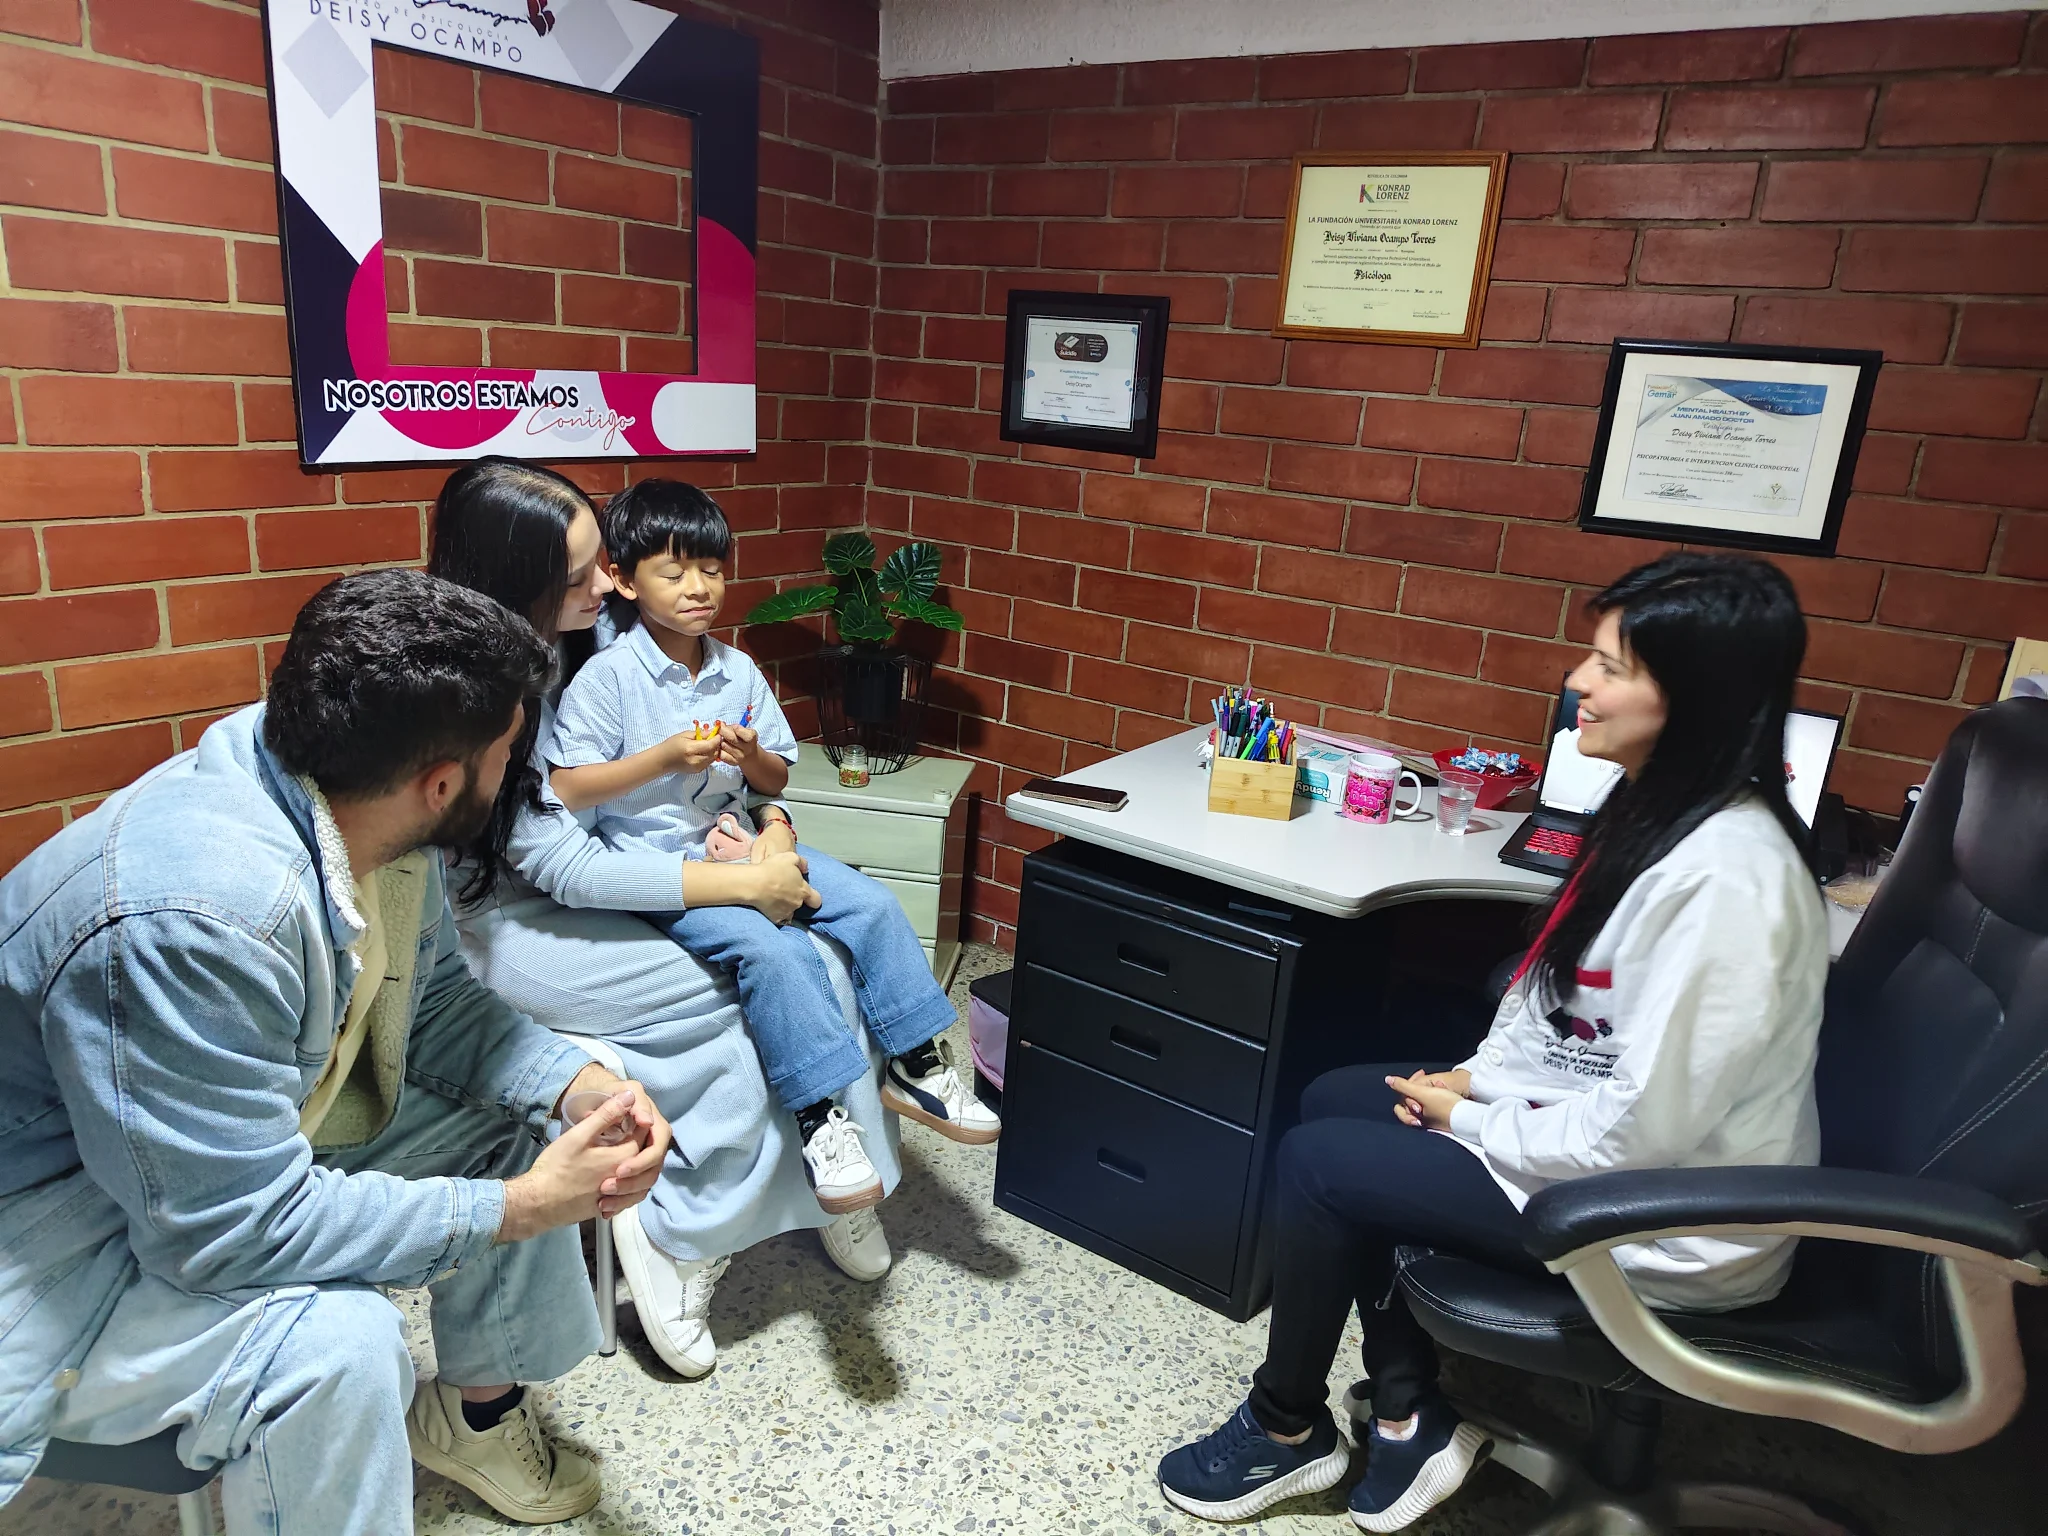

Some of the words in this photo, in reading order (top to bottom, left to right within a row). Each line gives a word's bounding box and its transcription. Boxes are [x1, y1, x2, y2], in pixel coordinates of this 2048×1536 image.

[310, 0, 390, 32] DEISY
[411, 22, 522, 62] OCAMPO
[1377, 184, 1411, 192] KONRAD
[1376, 192, 1410, 200] LORENZ
[1354, 217, 1402, 225] UNIVERSITARIA
[1403, 218, 1431, 226] KONRAD
[1323, 230, 1345, 245] Deisy
[1346, 230, 1377, 242] Viviana
[1411, 231, 1436, 244] Torres
[1354, 269, 1392, 282] Psicóloga
[325, 380, 470, 411] NOSOTROS
[477, 383, 579, 408] ESTAMOS
[1647, 390, 1676, 399] Gemar
[525, 401, 635, 450] Contigo
[1672, 428, 1693, 439] Deisy
[1694, 430, 1721, 440] Viviana
[1723, 432, 1753, 443] Ocampo
[1755, 434, 1777, 444] Torres
[1759, 464, 1800, 472] CONDUCTUAL
[1295, 781, 1331, 799] Rendy
[1574, 1065, 1613, 1079] OCAMP
